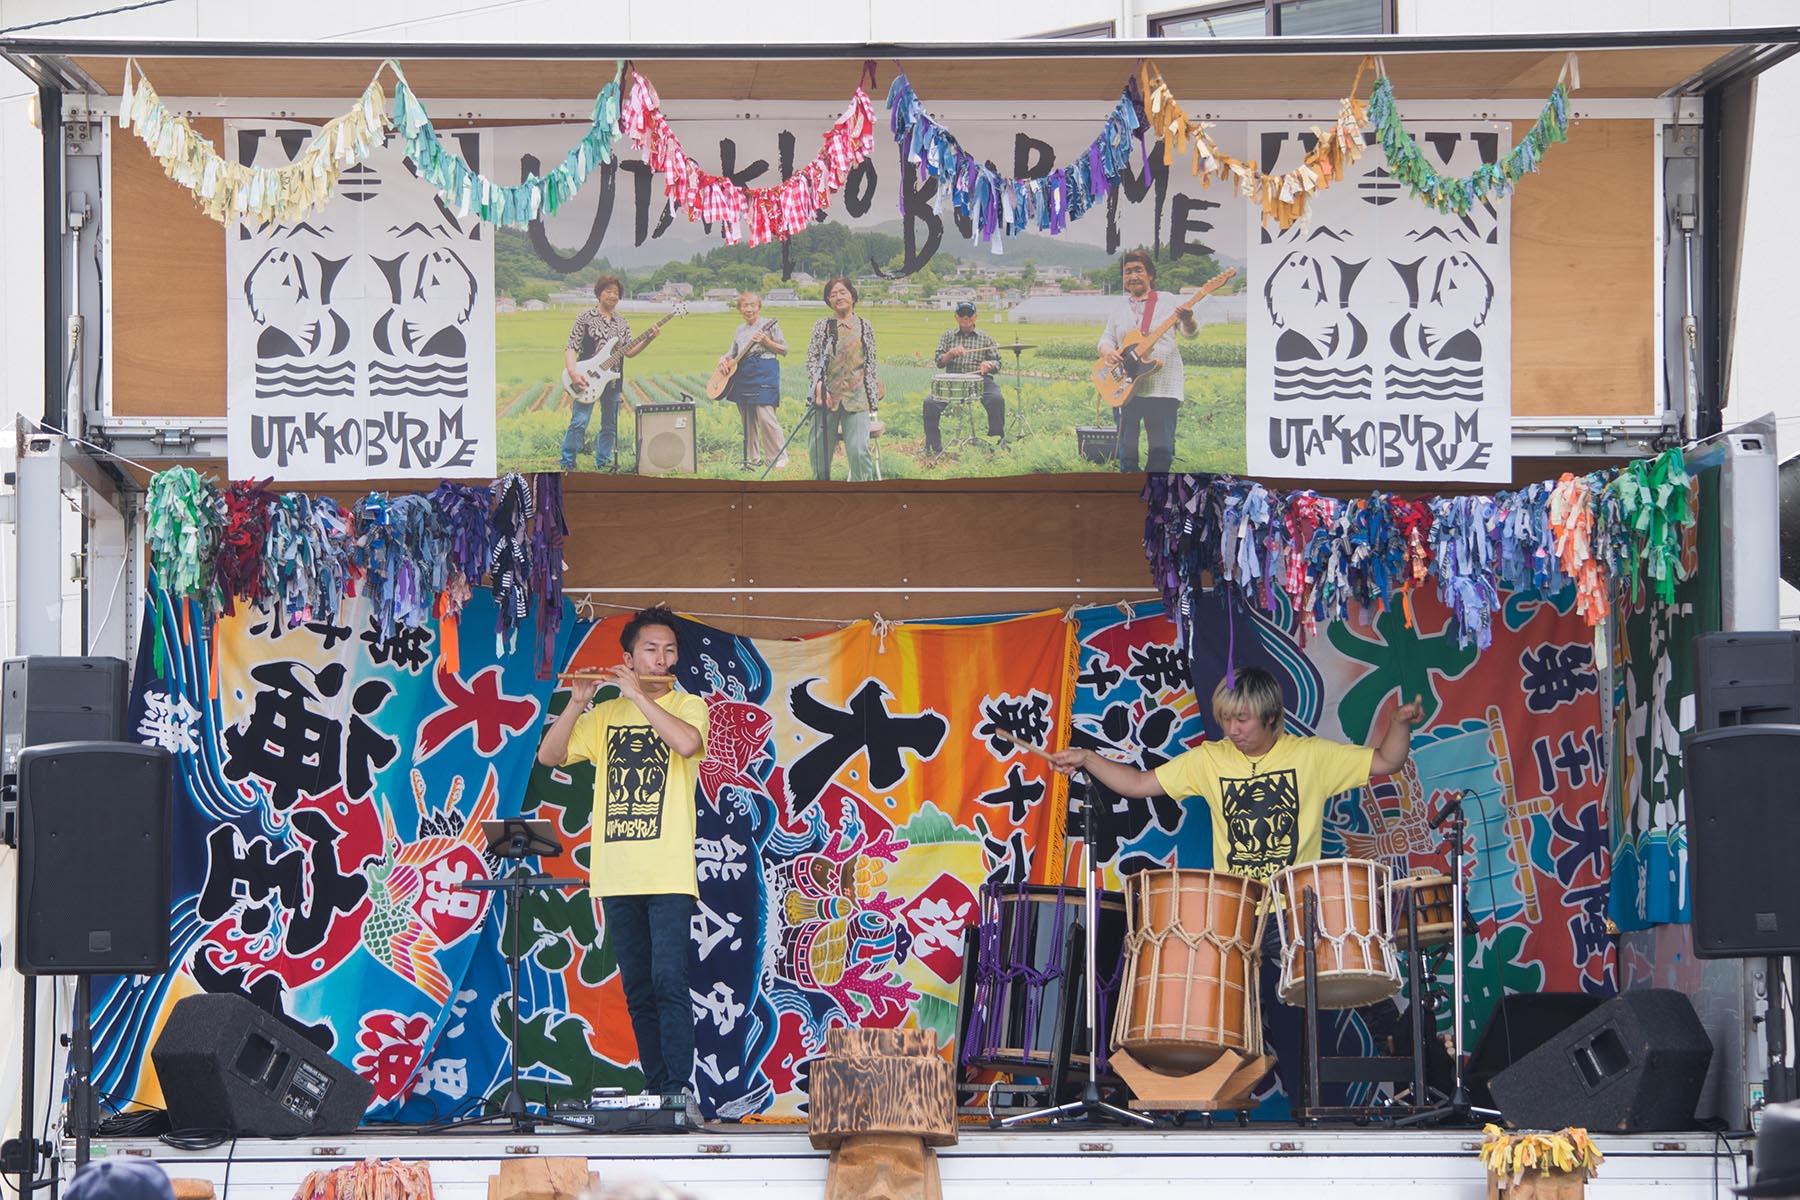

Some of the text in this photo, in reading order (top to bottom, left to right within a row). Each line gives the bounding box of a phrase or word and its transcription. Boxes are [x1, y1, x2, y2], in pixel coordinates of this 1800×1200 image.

[521, 129, 1221, 282] UTKOBME
[250, 403, 479, 471] UTAKKOBURUME
[1268, 407, 1495, 472] UTAKKOBURUME
[787, 678, 947, 826] 大
